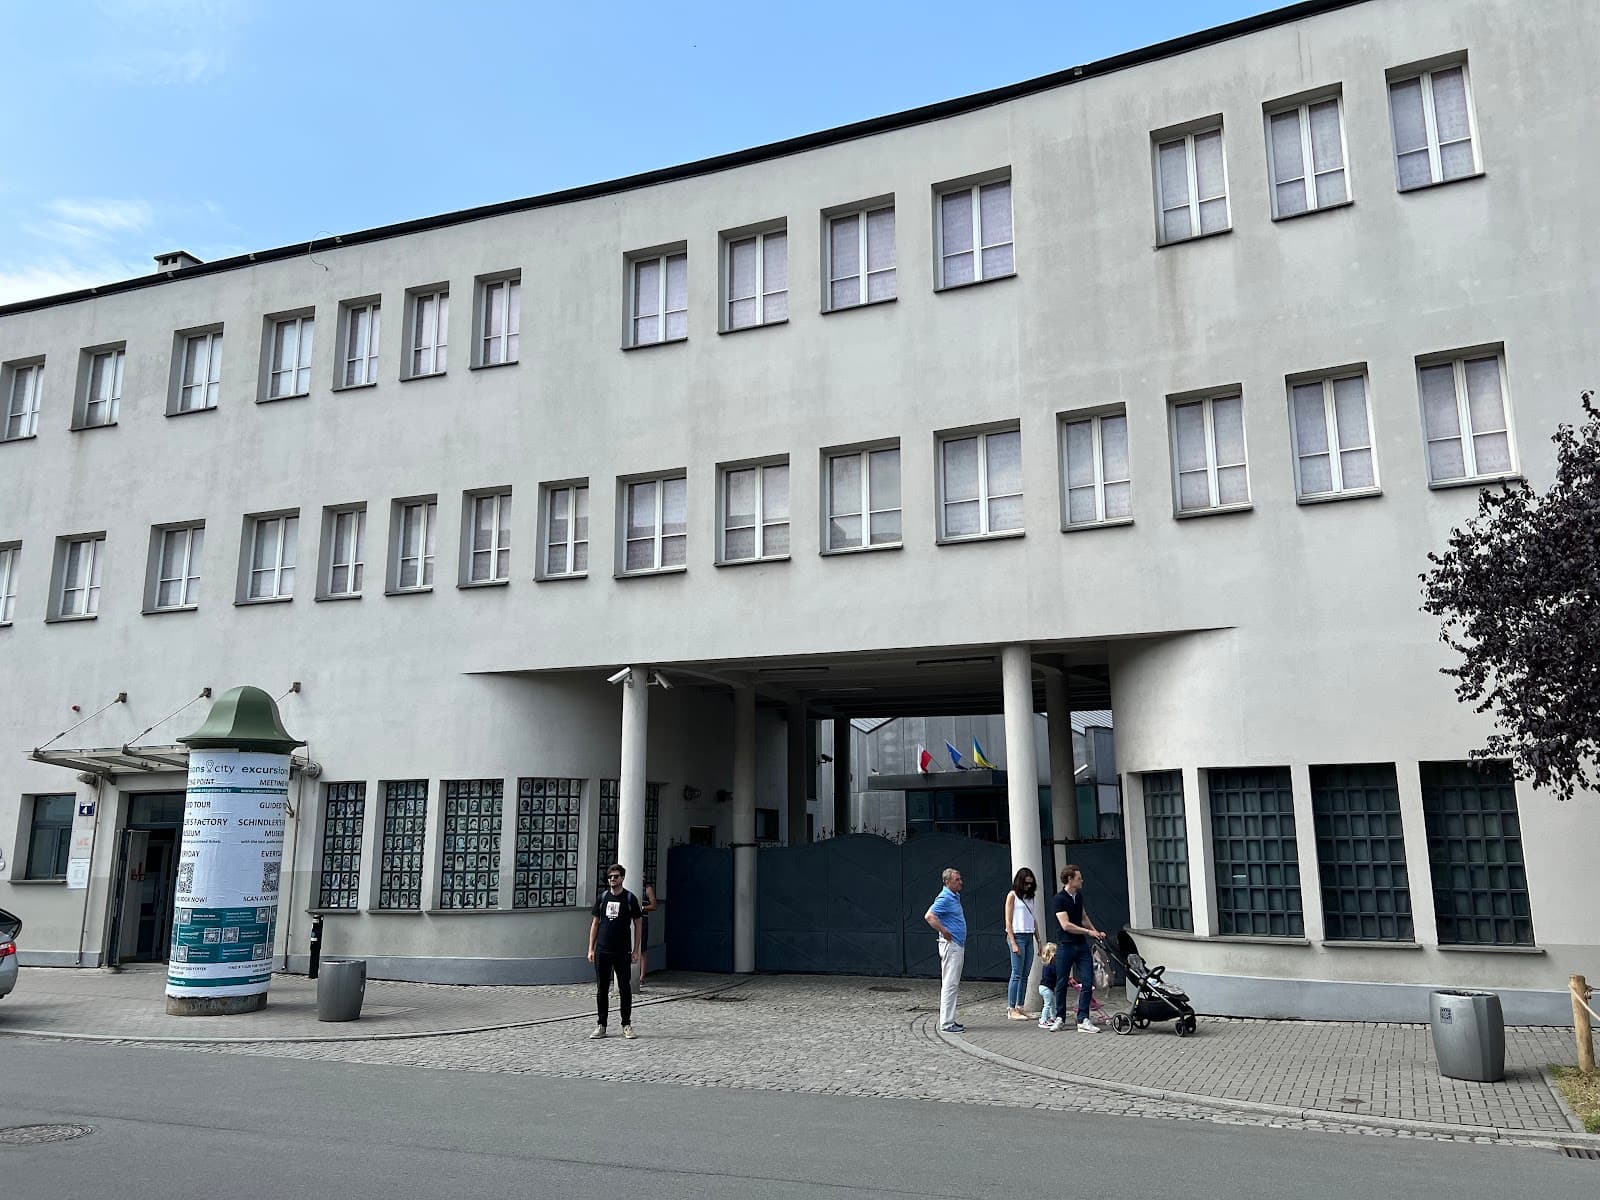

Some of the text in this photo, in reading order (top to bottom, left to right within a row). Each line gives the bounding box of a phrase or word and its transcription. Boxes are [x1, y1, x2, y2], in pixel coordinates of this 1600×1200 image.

[214, 764, 235, 774] city
[82, 806, 88, 815] 4
[194, 818, 228, 826] FACTORY
